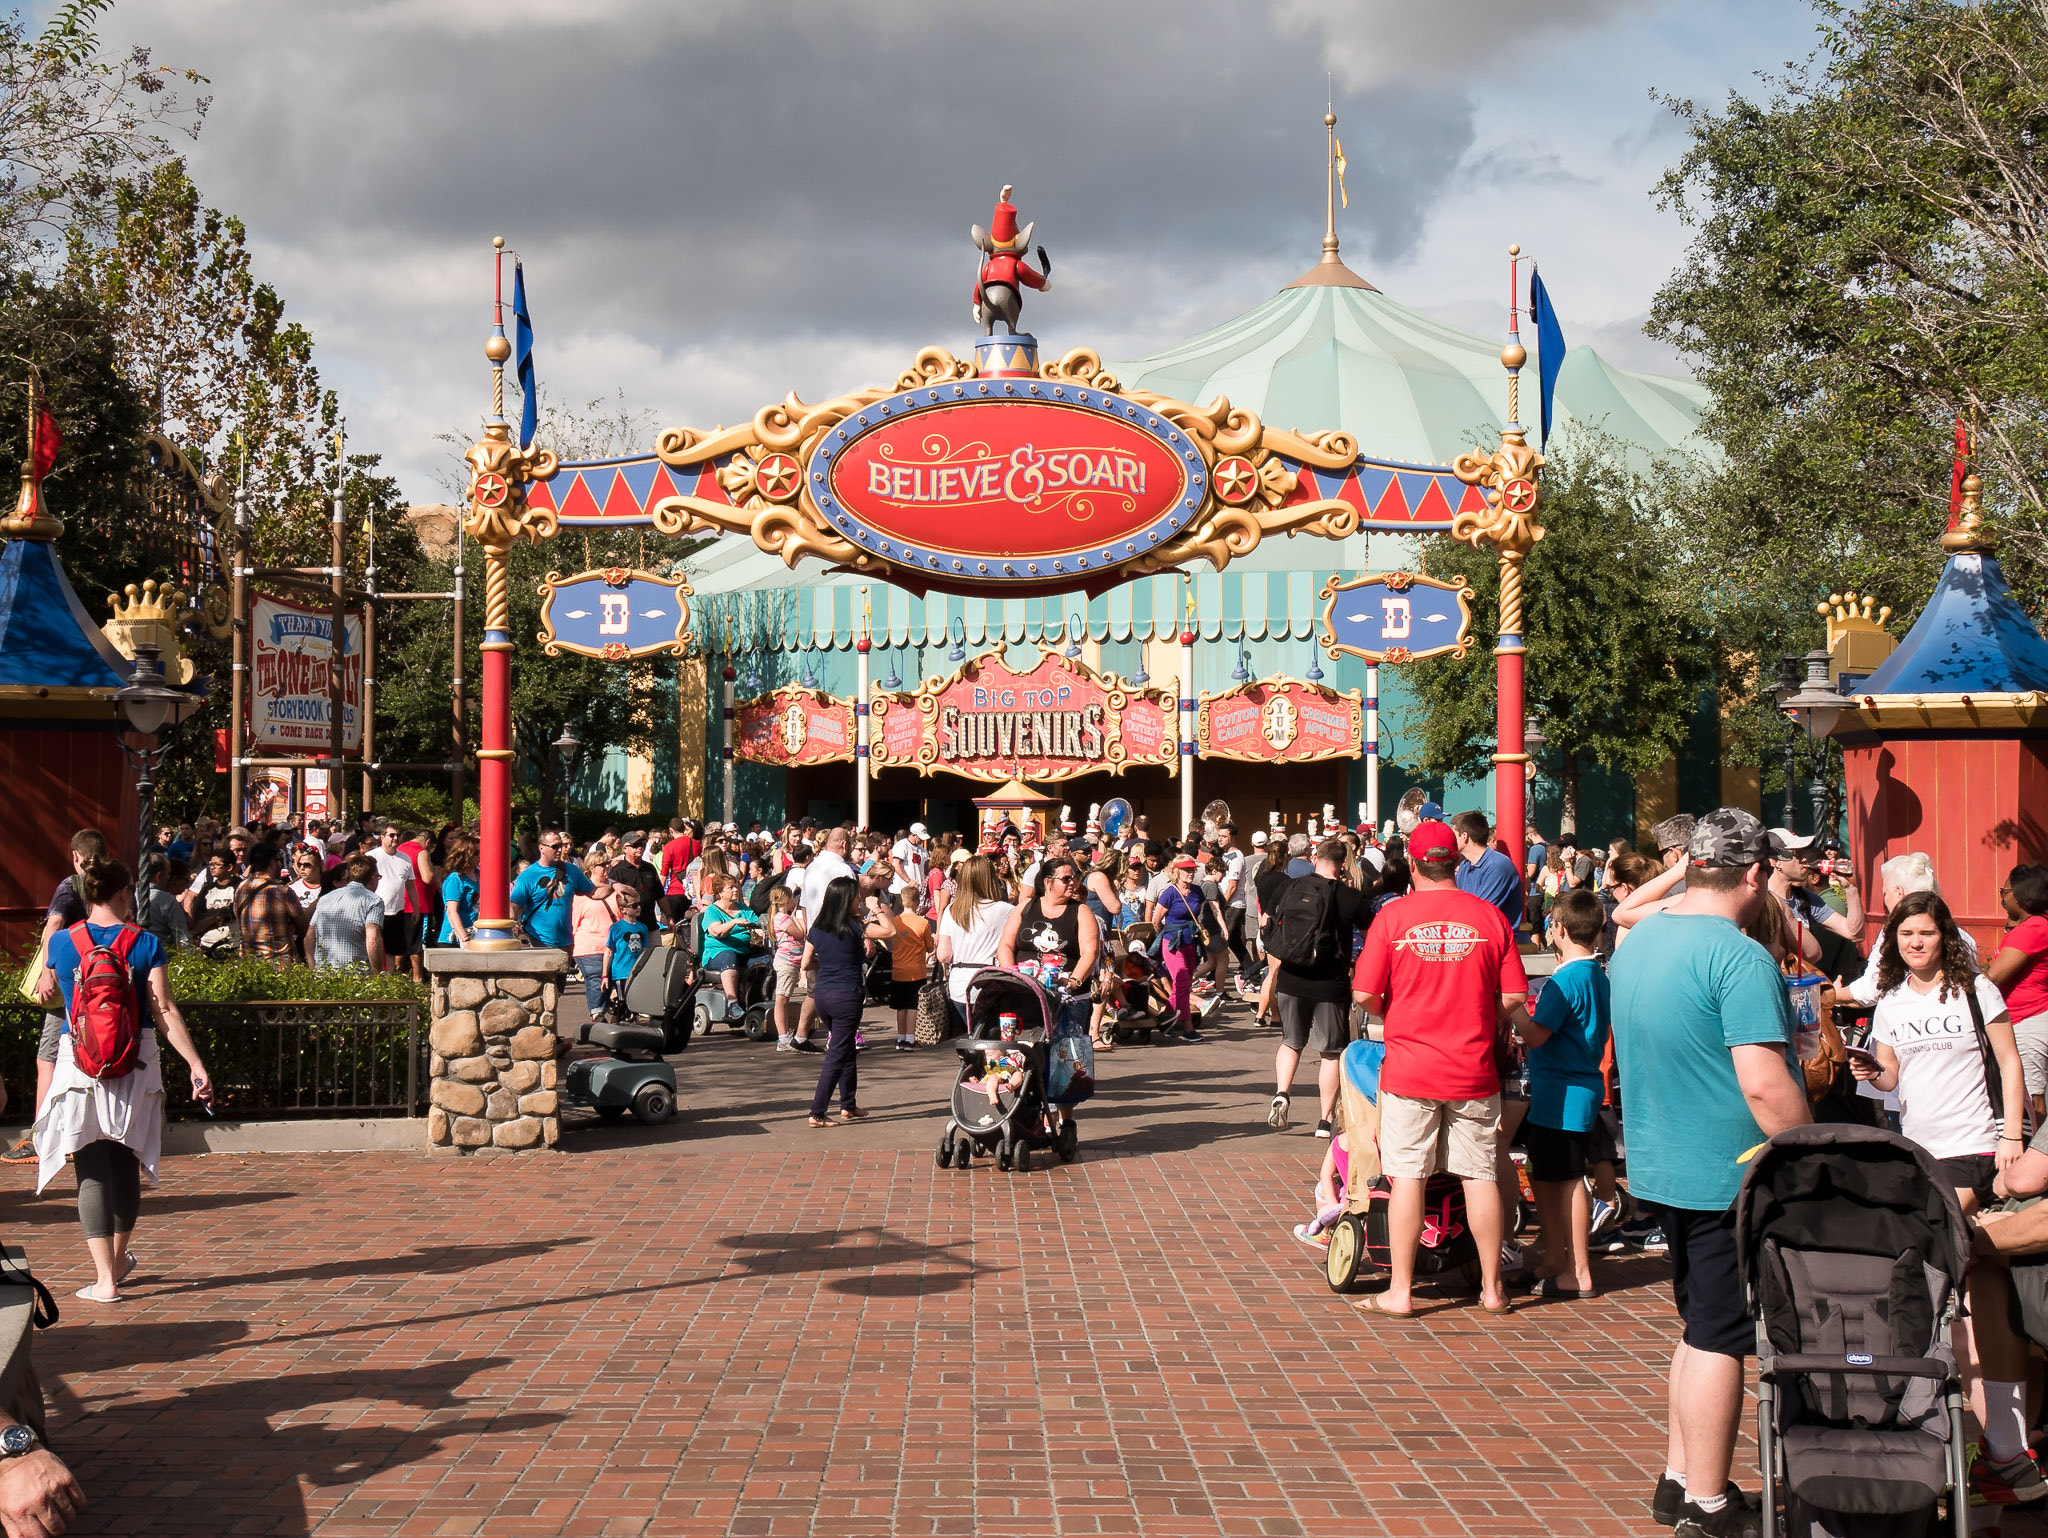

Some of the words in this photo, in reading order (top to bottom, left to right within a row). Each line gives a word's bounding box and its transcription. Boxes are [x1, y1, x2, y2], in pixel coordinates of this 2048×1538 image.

[868, 459, 1001, 503] BELIEVE
[1002, 444, 1045, 504] &
[1046, 452, 1147, 496] SOAR!
[599, 593, 631, 635] D
[1381, 597, 1413, 639] D
[278, 615, 317, 635] THANK
[319, 619, 334, 638] YO
[257, 653, 279, 691] THE
[278, 648, 311, 697] ONE
[975, 687, 1015, 708] BIG
[1023, 686, 1072, 708] TOP
[267, 699, 325, 722] STORYBOOK
[1215, 707, 1259, 728] COTTON
[1275, 702, 1286, 741] YUM
[1301, 706, 1349, 729] CARAMEL
[280, 725, 303, 739] COME
[305, 727, 324, 740] BACK
[941, 703, 1102, 760] SOUVENIRS
[1218, 721, 1256, 741] CANDY
[1304, 721, 1346, 742] APPLES
[1413, 925, 1442, 940] RON
[1443, 925, 1473, 939] JON
[1416, 943, 1441, 954] SURF
[1444, 942, 1469, 954] SHOP
[1890, 1014, 1963, 1042] UNCG
[1902, 1043, 1931, 1056] RUNNING
[1933, 1041, 1953, 1051] CLUB
